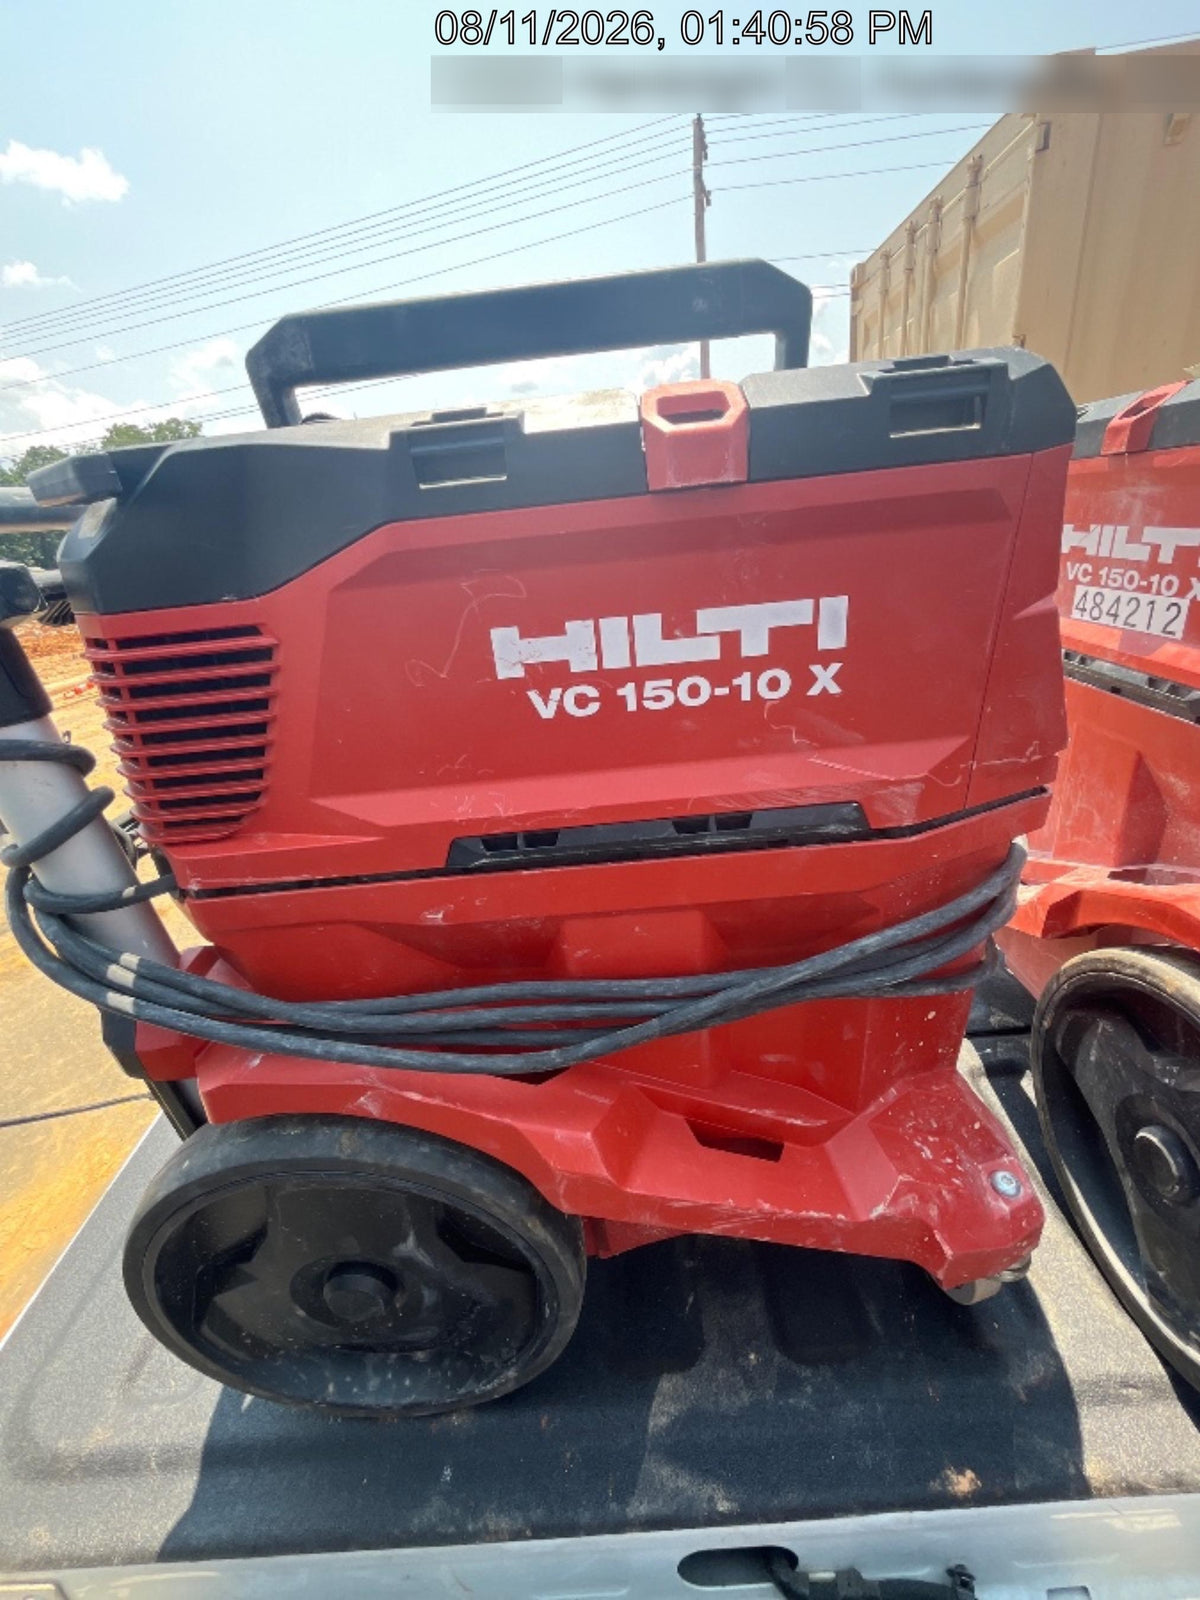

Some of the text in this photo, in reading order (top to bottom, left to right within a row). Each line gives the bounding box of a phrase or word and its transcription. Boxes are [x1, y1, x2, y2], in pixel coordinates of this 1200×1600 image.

[1061, 523, 1200, 568] HILT
[1066, 561, 1093, 584] VC
[1098, 566, 1180, 597] 150-10
[1074, 589, 1182, 636] 484212
[490, 595, 849, 680] HILTI
[527, 662, 844, 719] VC 150-10 X
